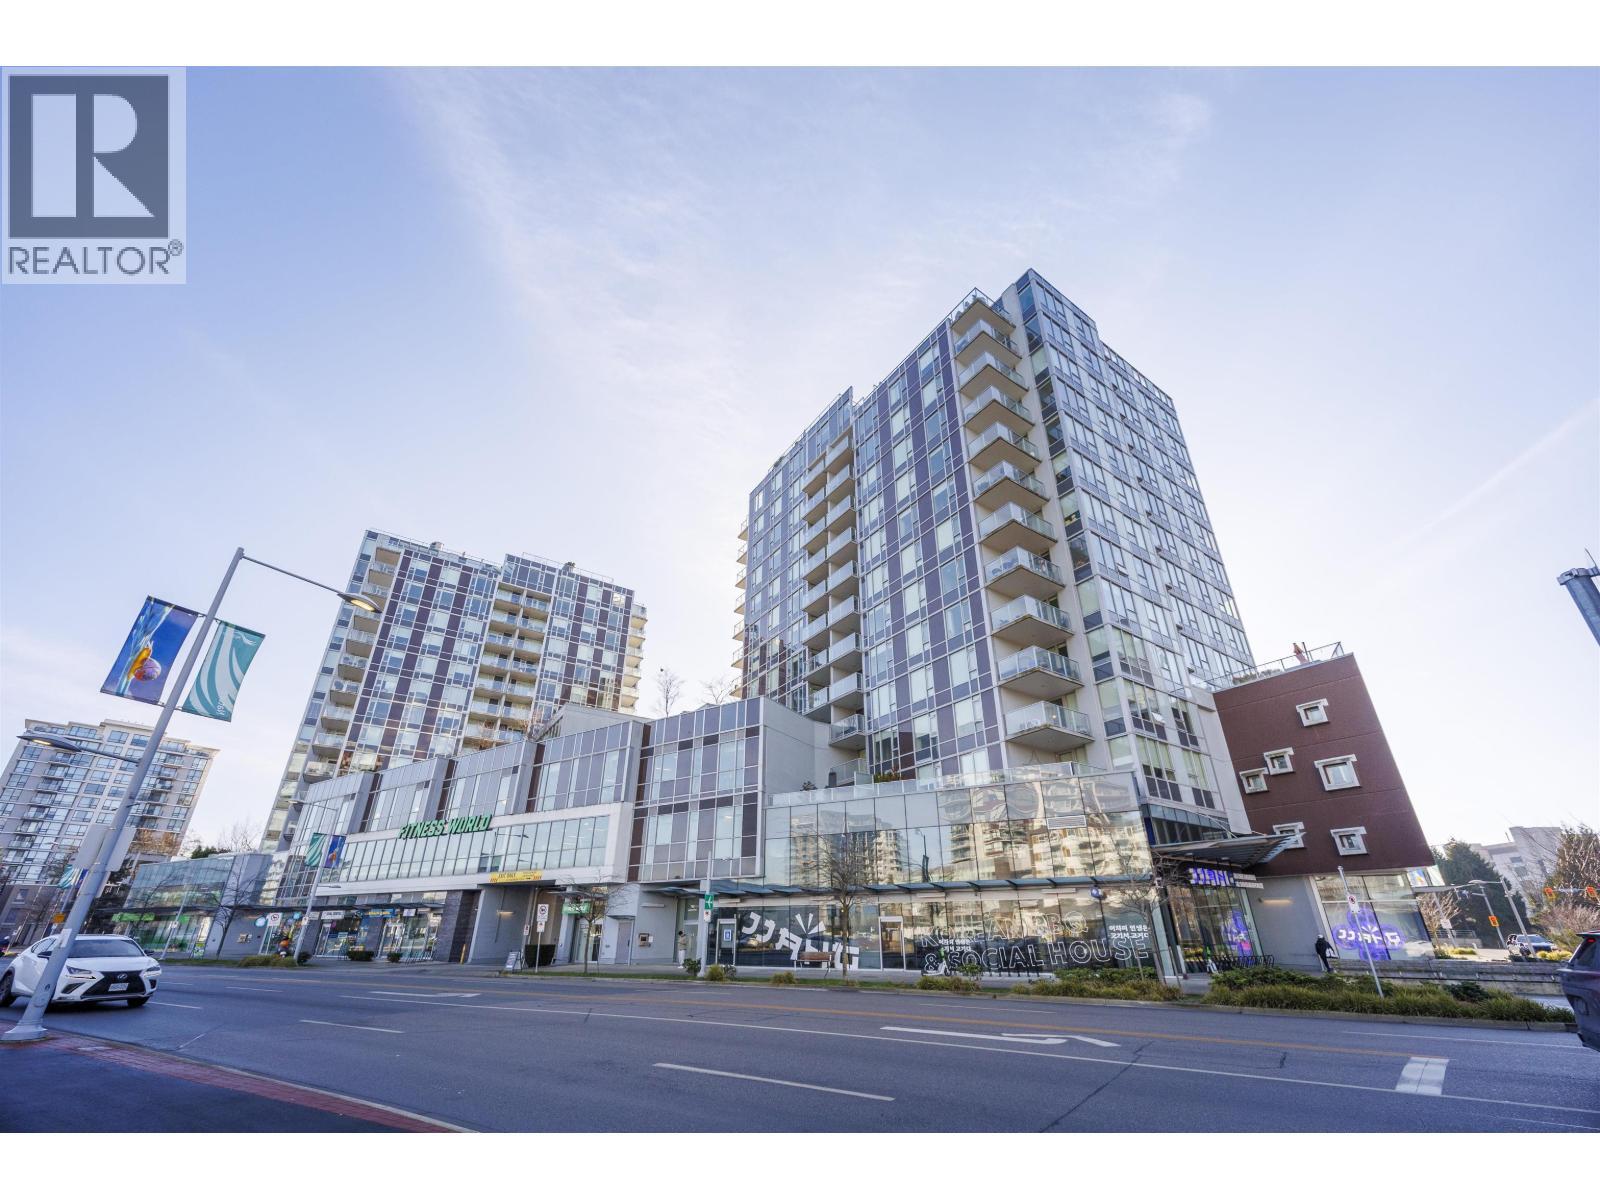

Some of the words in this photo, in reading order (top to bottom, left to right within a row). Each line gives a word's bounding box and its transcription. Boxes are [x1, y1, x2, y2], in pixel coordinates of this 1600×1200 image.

[398, 819, 447, 840] FITNESS
[448, 815, 493, 834] WORLD
[924, 952, 938, 972] &
[948, 944, 1045, 972] SOCIAL
[1048, 936, 1149, 965] HOUSE
